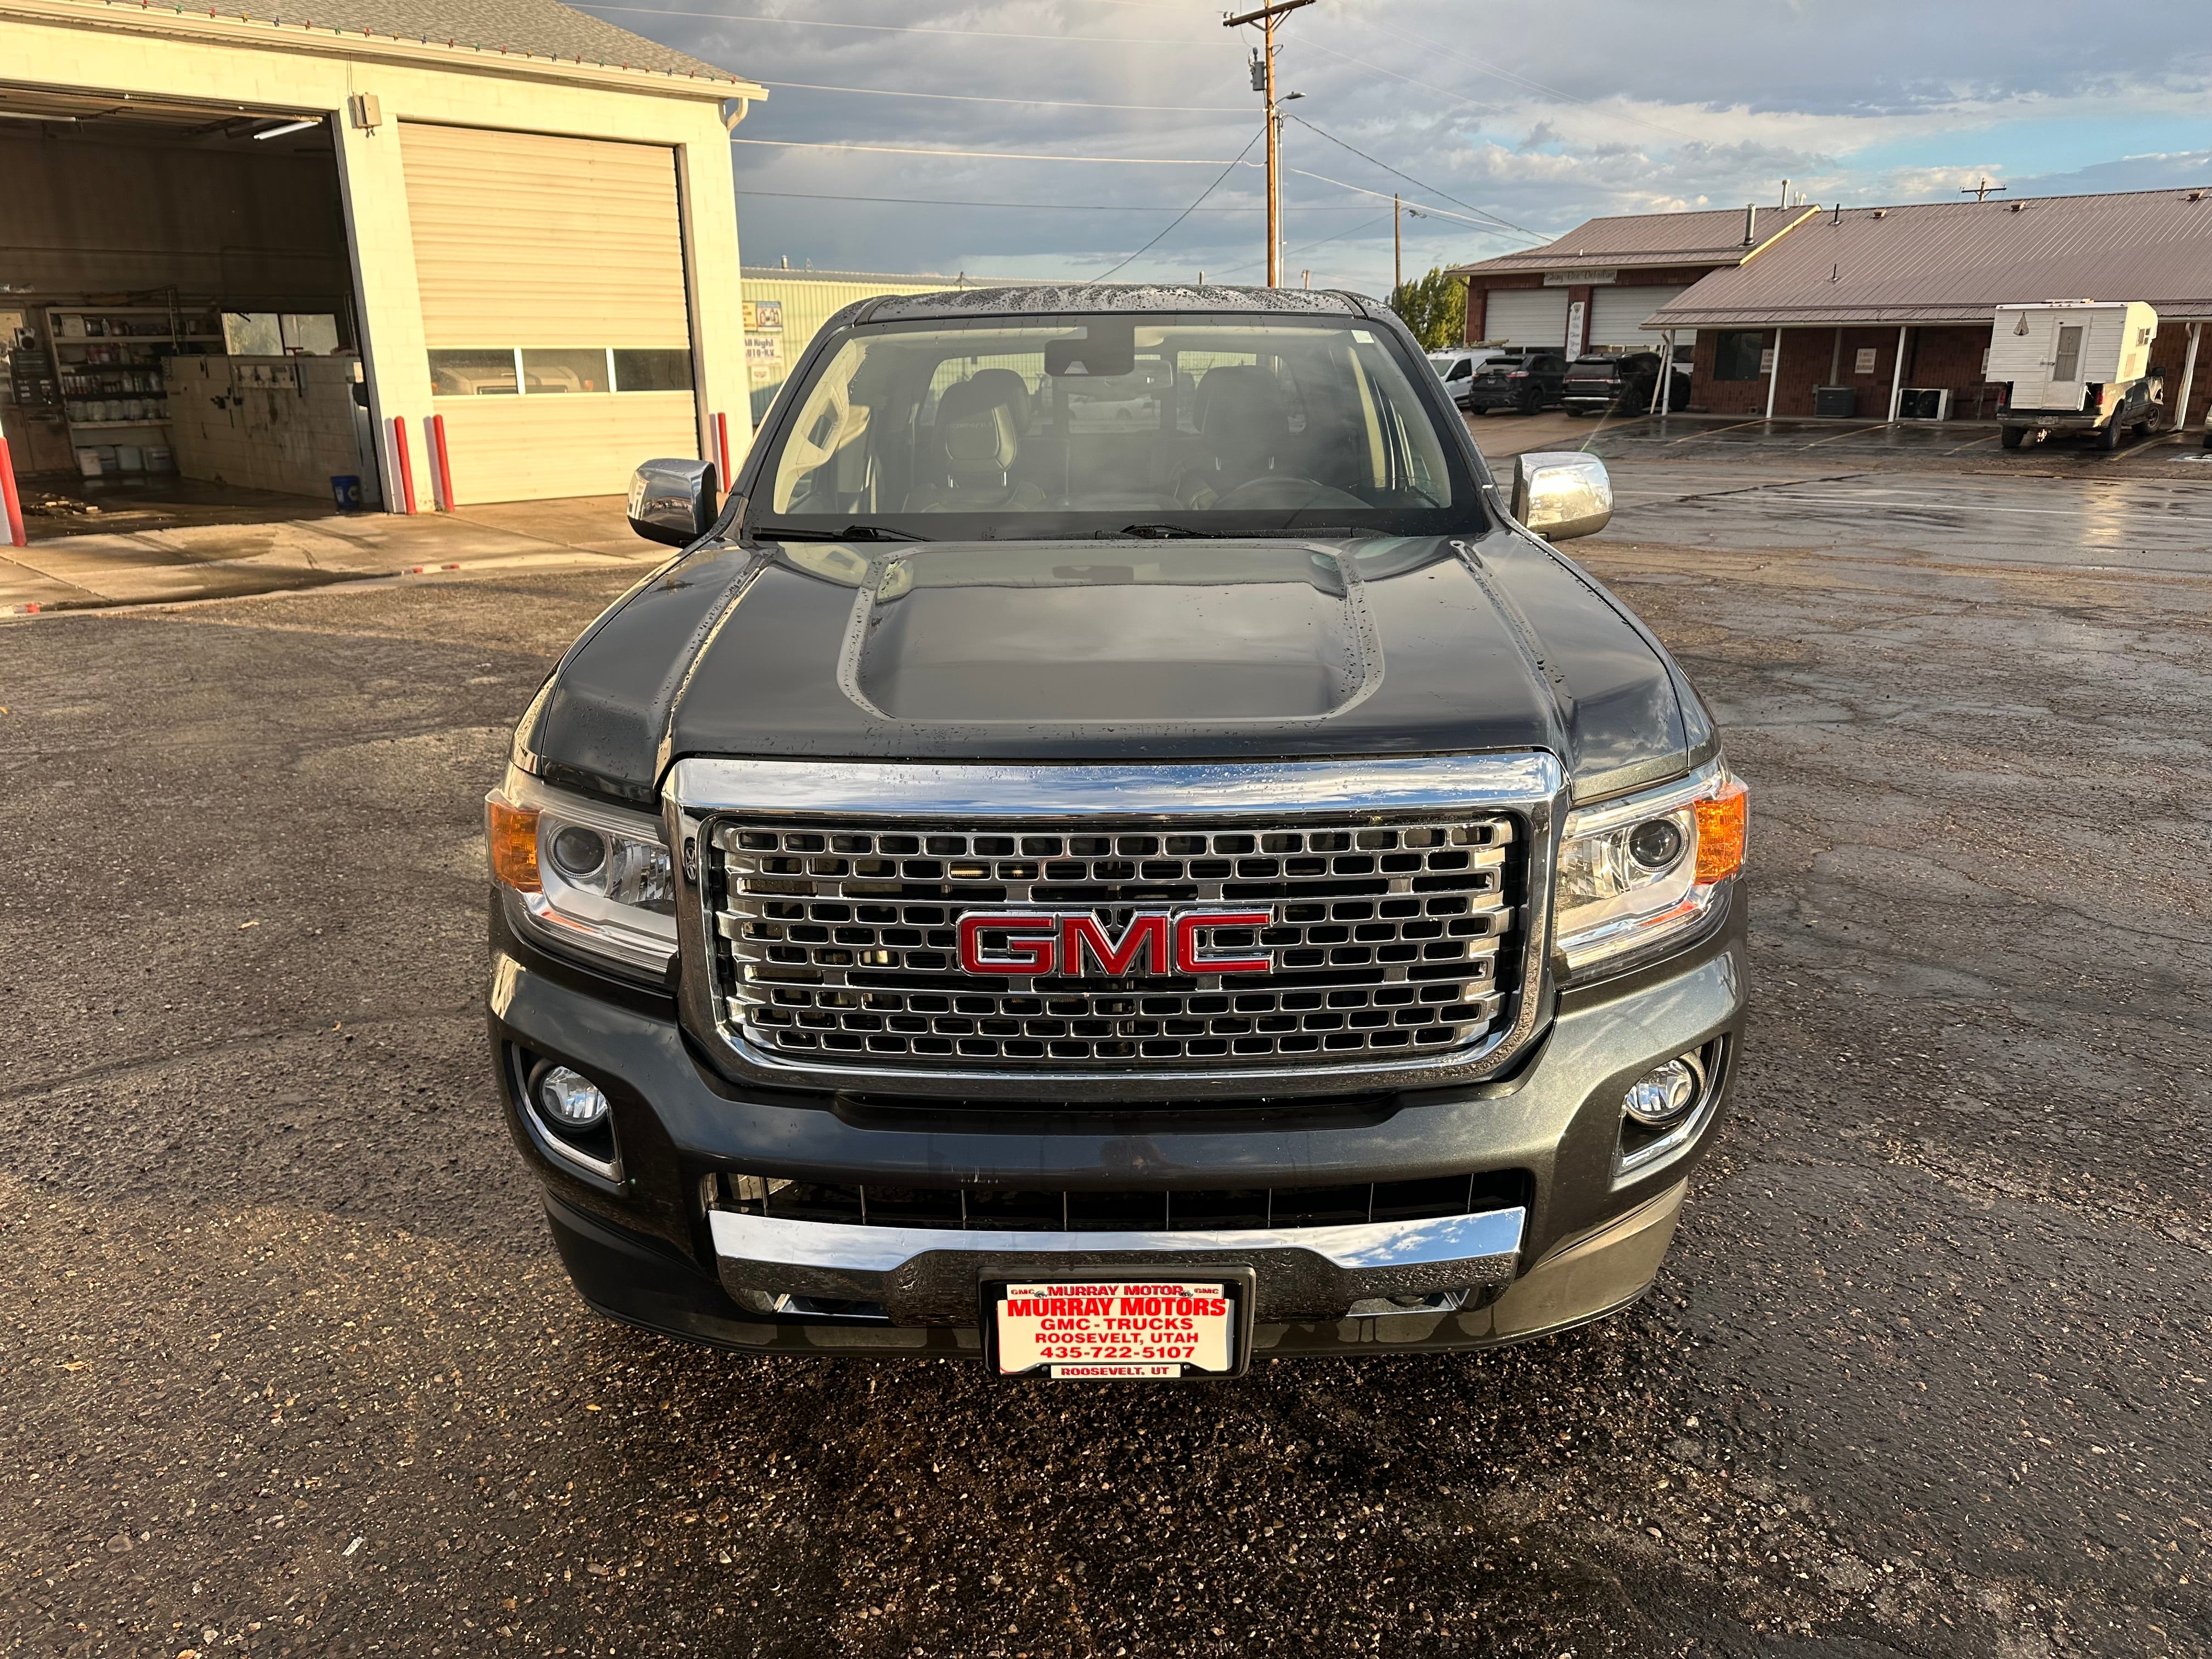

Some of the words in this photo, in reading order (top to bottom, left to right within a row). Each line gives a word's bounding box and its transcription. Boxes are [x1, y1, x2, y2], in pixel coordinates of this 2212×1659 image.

[754, 338, 774, 348] Right
[956, 907, 1274, 978] GMC
[1047, 1285, 1119, 1296] MURRAY
[1124, 1285, 1193, 1296] MOTOR
[1008, 1298, 1114, 1317] MURRAY
[1121, 1298, 1226, 1316] MOTORS
[1035, 1333, 1144, 1345] ROOSEVELT,
[1150, 1333, 1199, 1343] UTAH
[1040, 1346, 1195, 1358] 435-722-5107
[1151, 1367, 1170, 1375] UT
